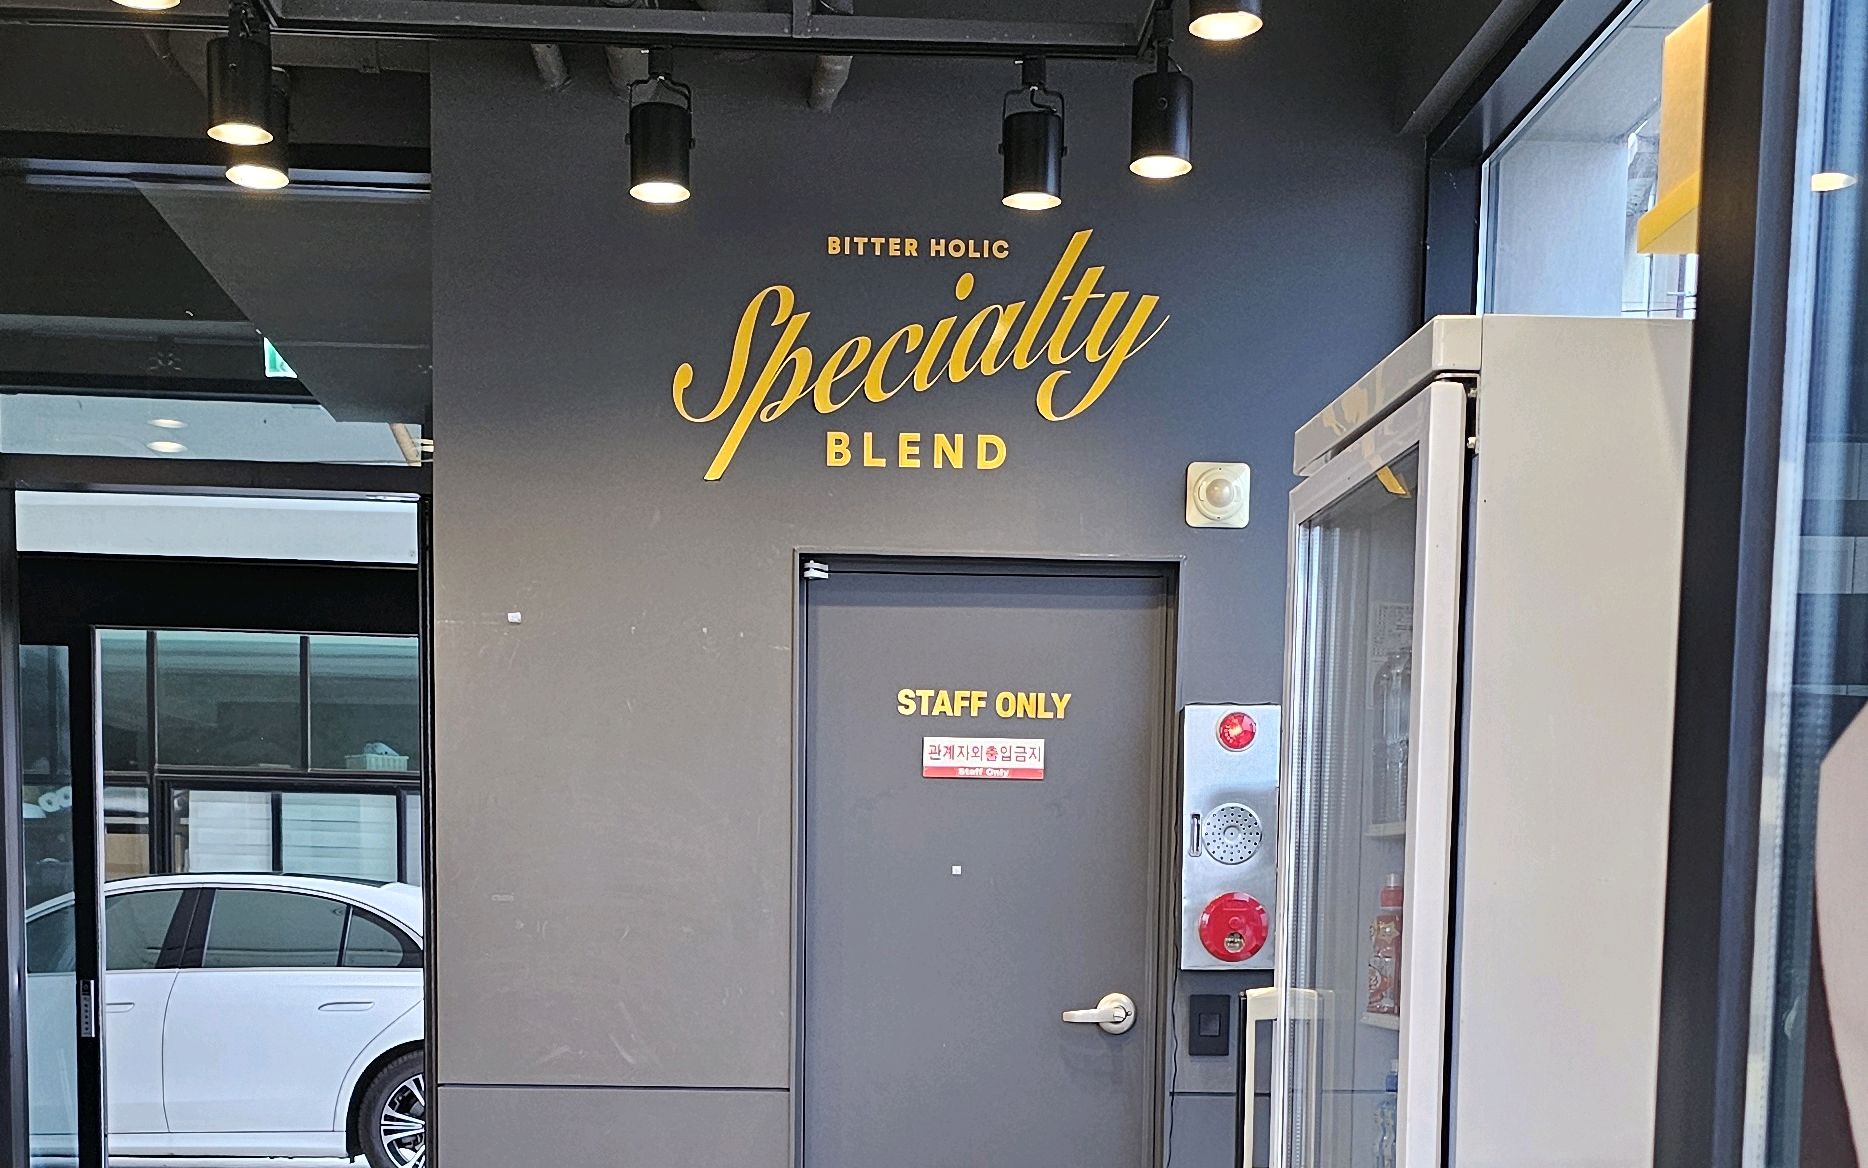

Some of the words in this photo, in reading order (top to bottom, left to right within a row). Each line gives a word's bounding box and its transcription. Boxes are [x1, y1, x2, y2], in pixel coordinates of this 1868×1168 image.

[827, 236, 918, 257] BITTER
[930, 238, 1010, 259] HOLIC
[672, 229, 1170, 481] Specialty
[826, 431, 1007, 470] BLEND
[897, 688, 988, 717] STAFF
[995, 691, 1072, 720] ONLY
[927, 743, 1042, 763] 관계자외출입금지
[957, 767, 984, 776] Staff
[985, 767, 1009, 777] Only
